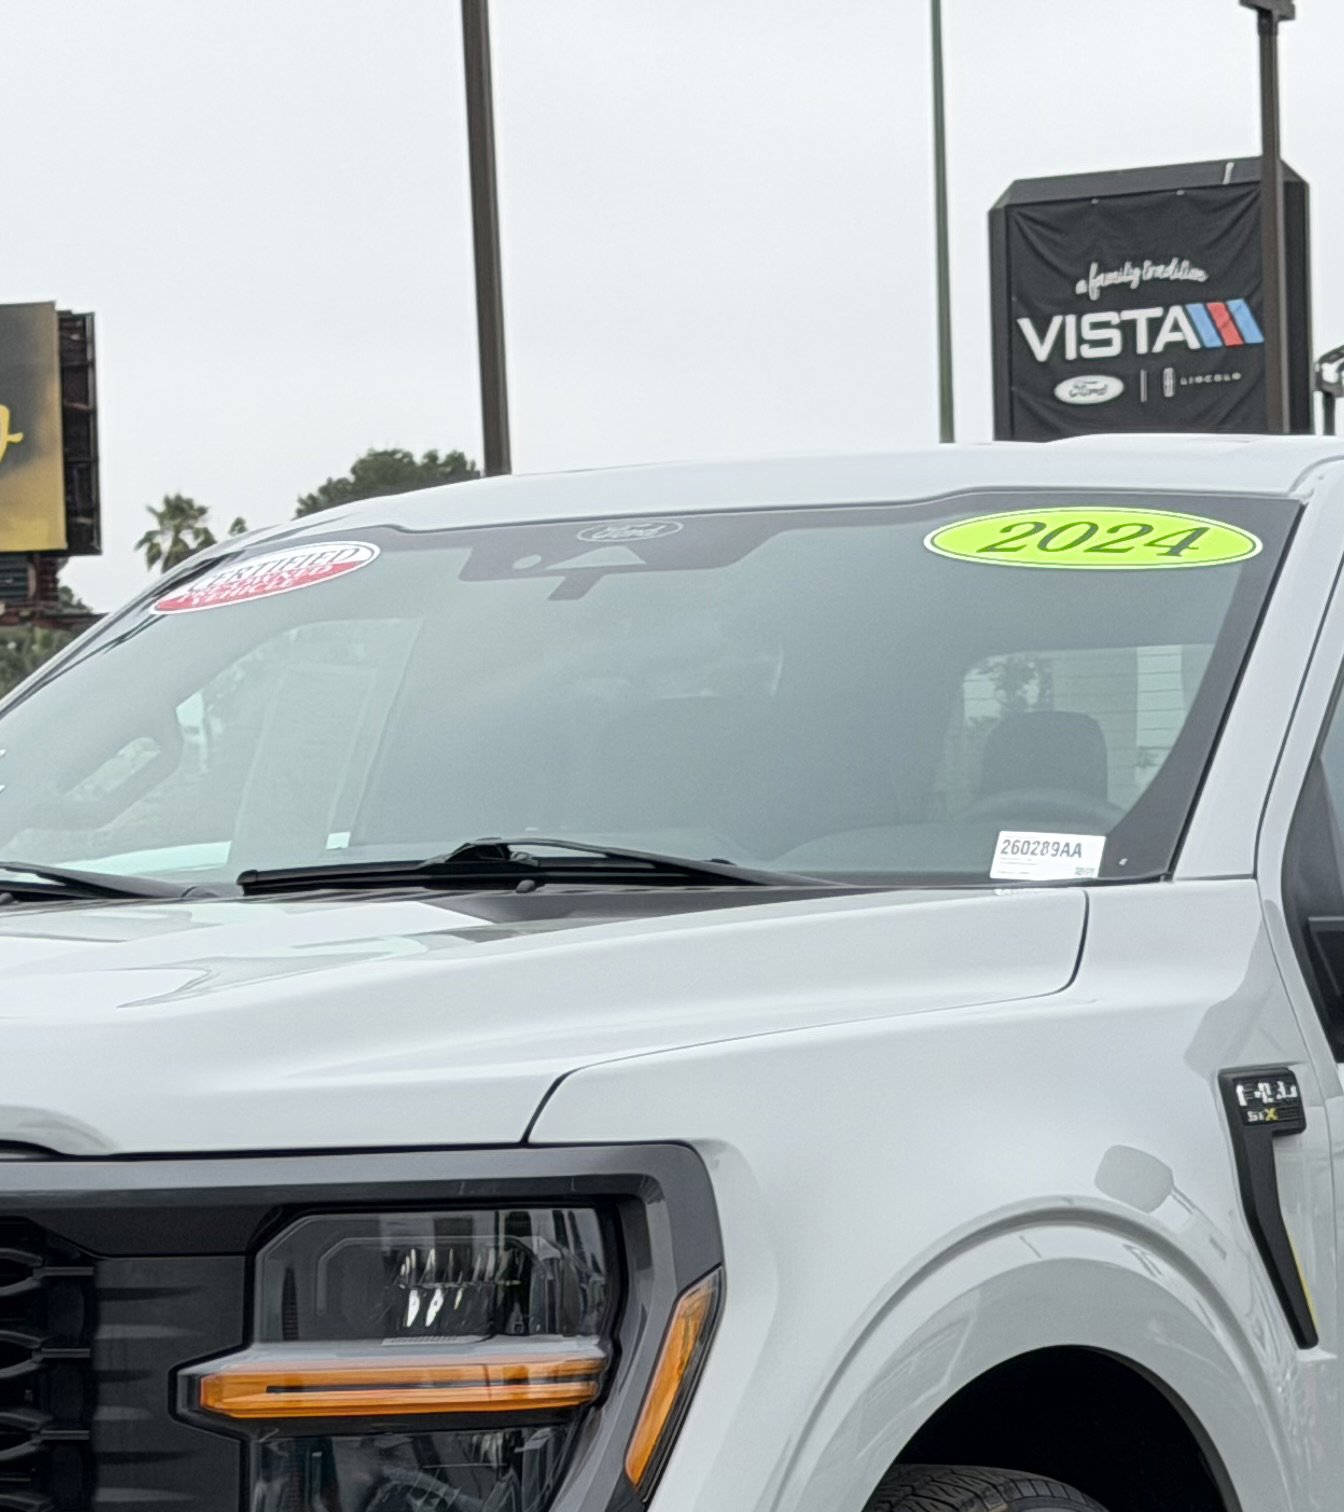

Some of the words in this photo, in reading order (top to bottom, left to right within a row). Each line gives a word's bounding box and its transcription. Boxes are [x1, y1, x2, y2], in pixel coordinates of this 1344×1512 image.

[1016, 304, 1202, 363] VISTA
[591, 522, 667, 540] Ford
[976, 520, 1211, 558] 2024
[187, 546, 361, 594] CERTIFIED
[999, 838, 1083, 859] 260289AA
